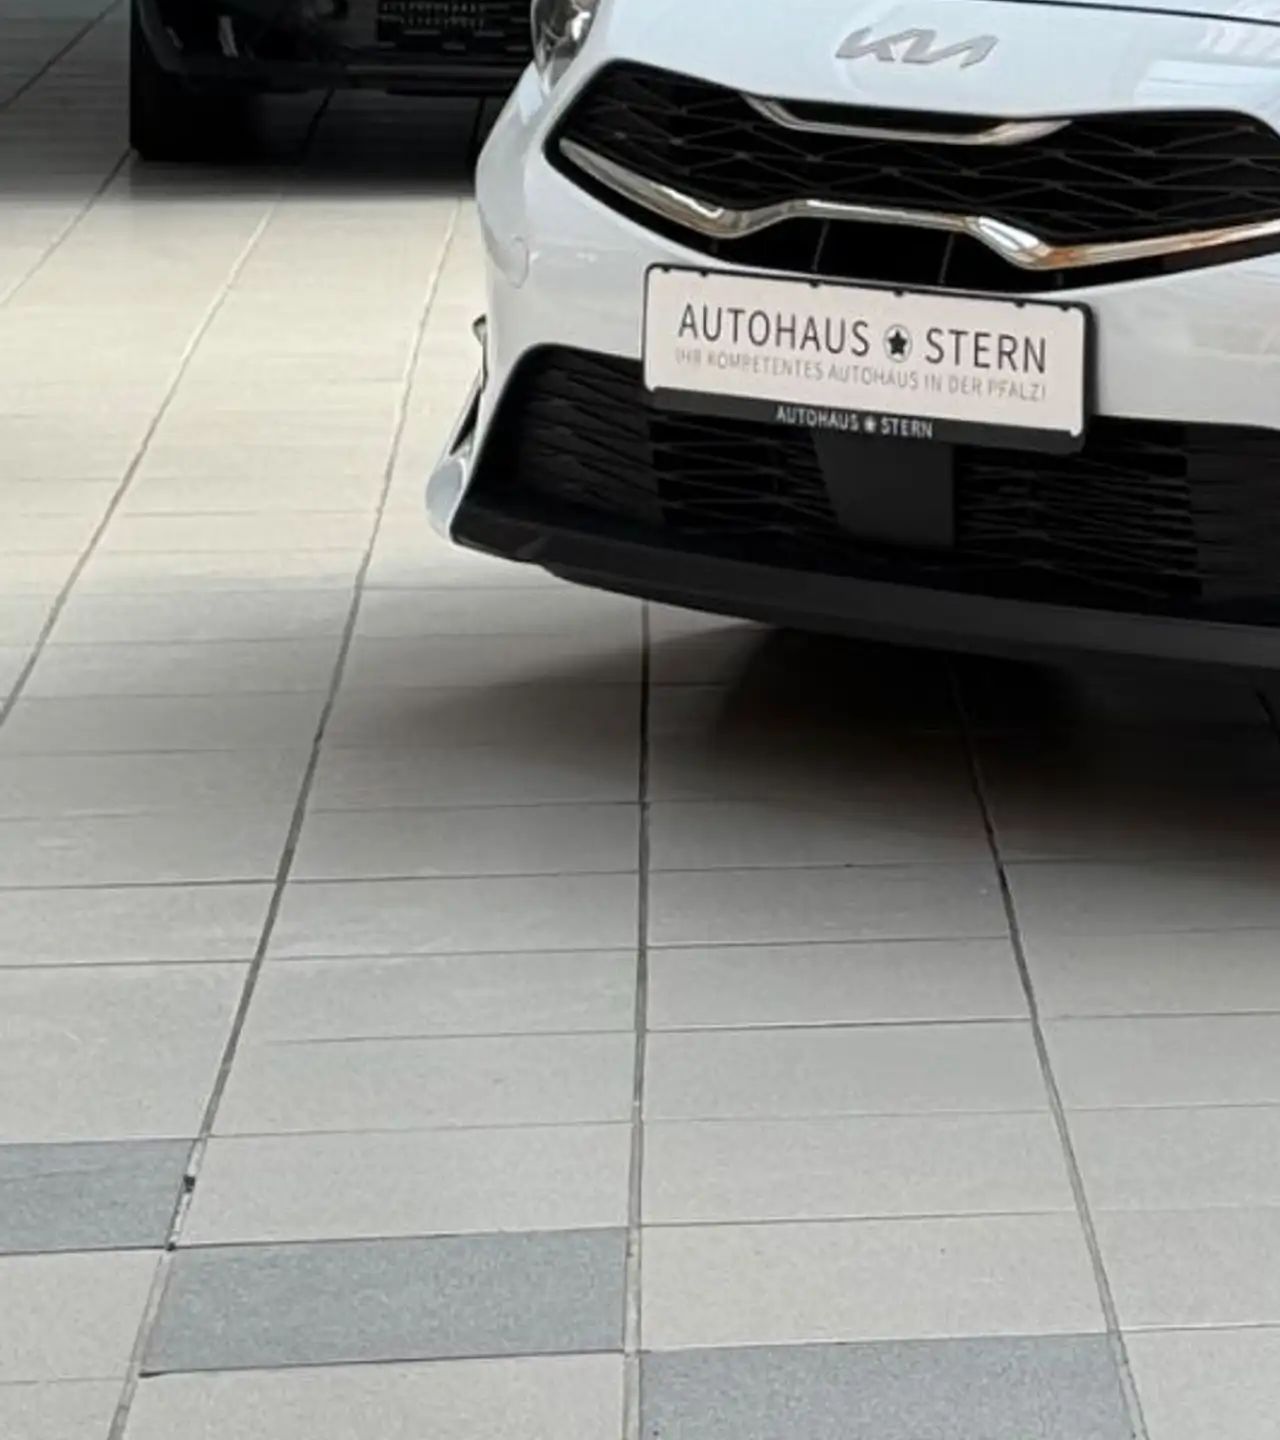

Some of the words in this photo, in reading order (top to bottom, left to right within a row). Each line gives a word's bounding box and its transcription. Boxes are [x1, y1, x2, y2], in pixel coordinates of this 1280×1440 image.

[677, 301, 871, 358] AUTOHAUS
[925, 326, 1047, 375] STERN
[707, 349, 824, 381] KOMPETENTES
[827, 363, 919, 392] AUTOHAUS
[924, 373, 943, 393] IN
[948, 374, 982, 398] DER
[775, 405, 860, 432] AUTOHAUS
[880, 416, 934, 440] STERN
